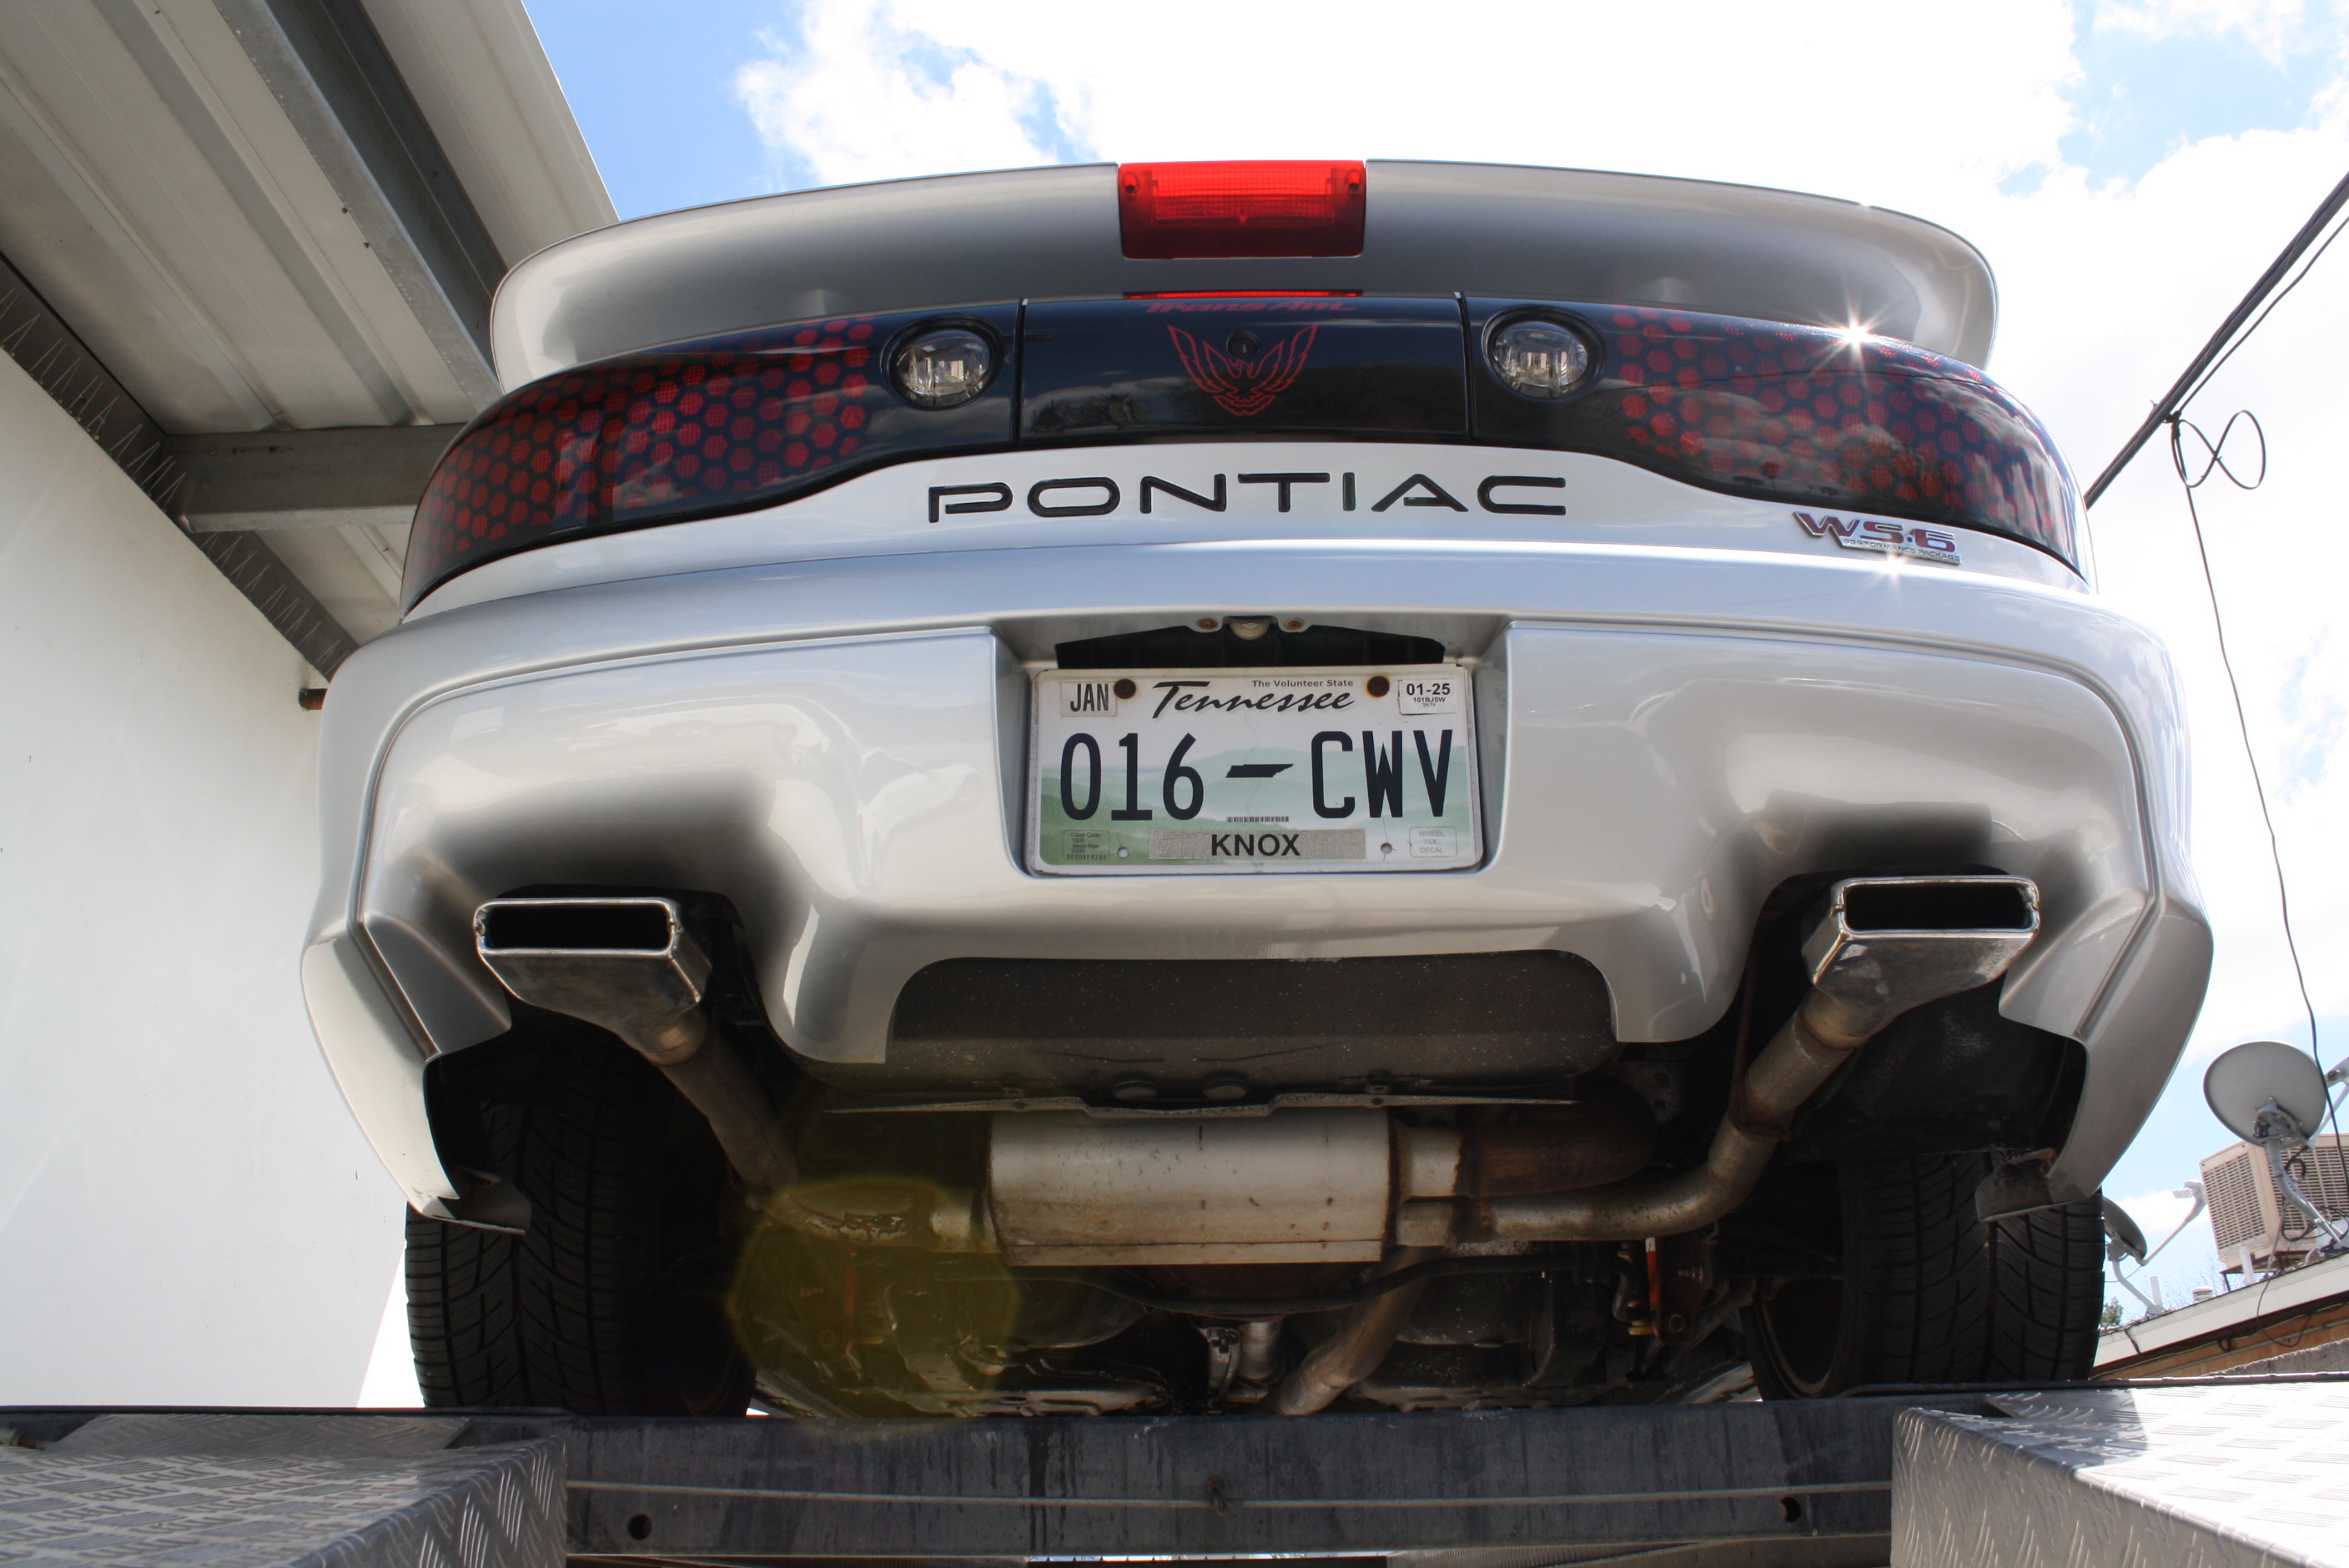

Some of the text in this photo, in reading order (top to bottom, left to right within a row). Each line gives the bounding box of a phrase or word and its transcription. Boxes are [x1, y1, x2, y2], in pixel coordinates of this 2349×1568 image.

[1140, 299, 1356, 313] Trans Am
[928, 472, 1566, 523] PONTIAC
[1843, 539, 1960, 562] PERFORMANCE PACKAGE
[1326, 679, 1354, 687] State
[1406, 683, 1451, 696] 01-25
[1070, 683, 1109, 711] JAN
[1152, 681, 1355, 719] Tennessee
[1211, 834, 1300, 857] KNOX
